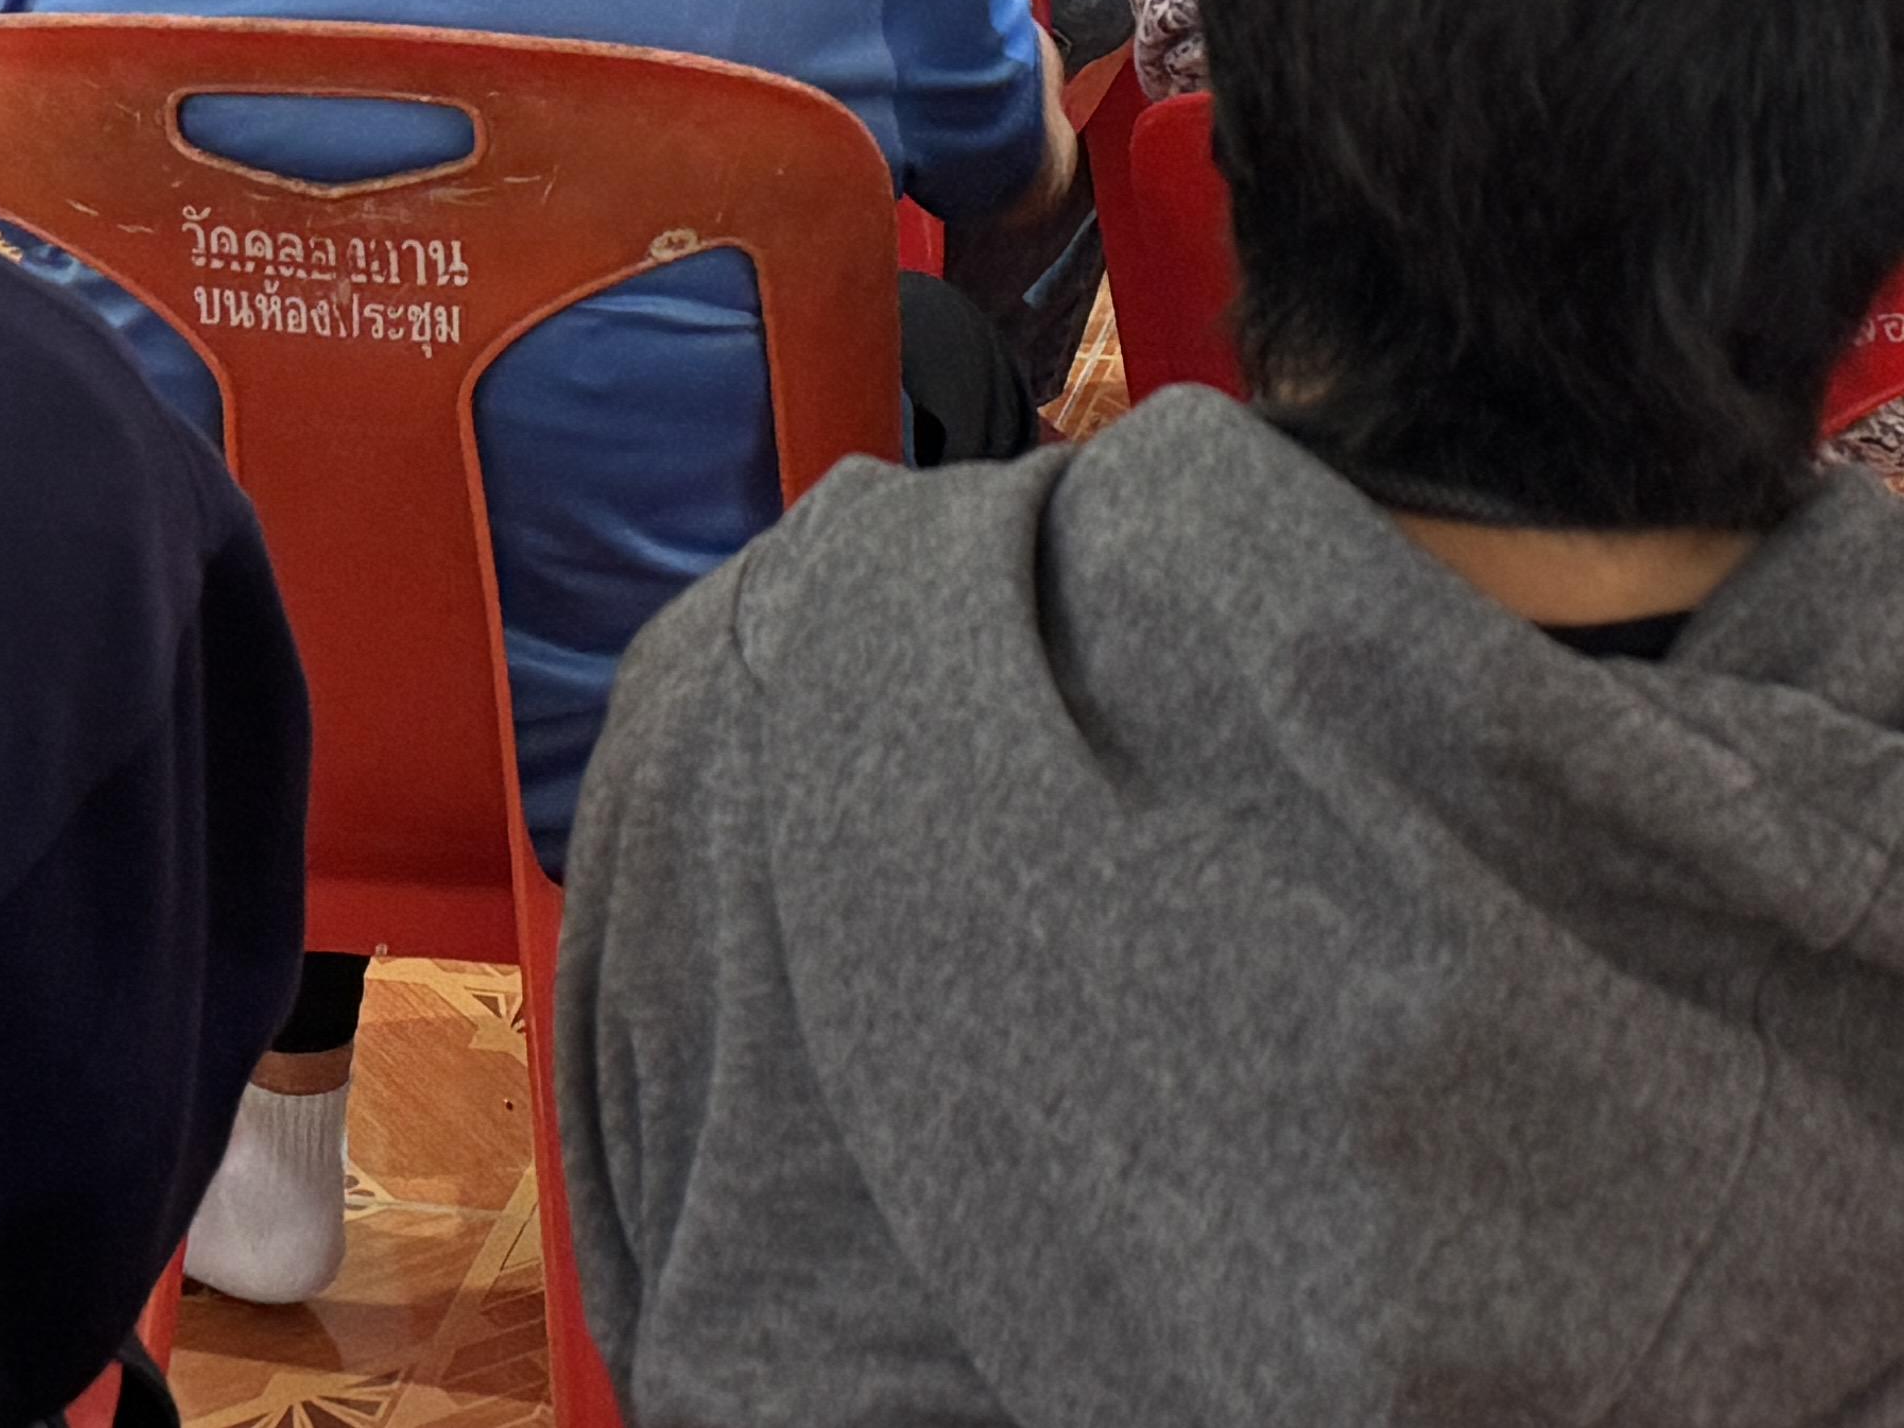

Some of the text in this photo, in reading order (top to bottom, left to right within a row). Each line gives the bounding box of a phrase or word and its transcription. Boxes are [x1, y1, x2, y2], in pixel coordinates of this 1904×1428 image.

[194, 281, 462, 359] บนห้องประชุม
